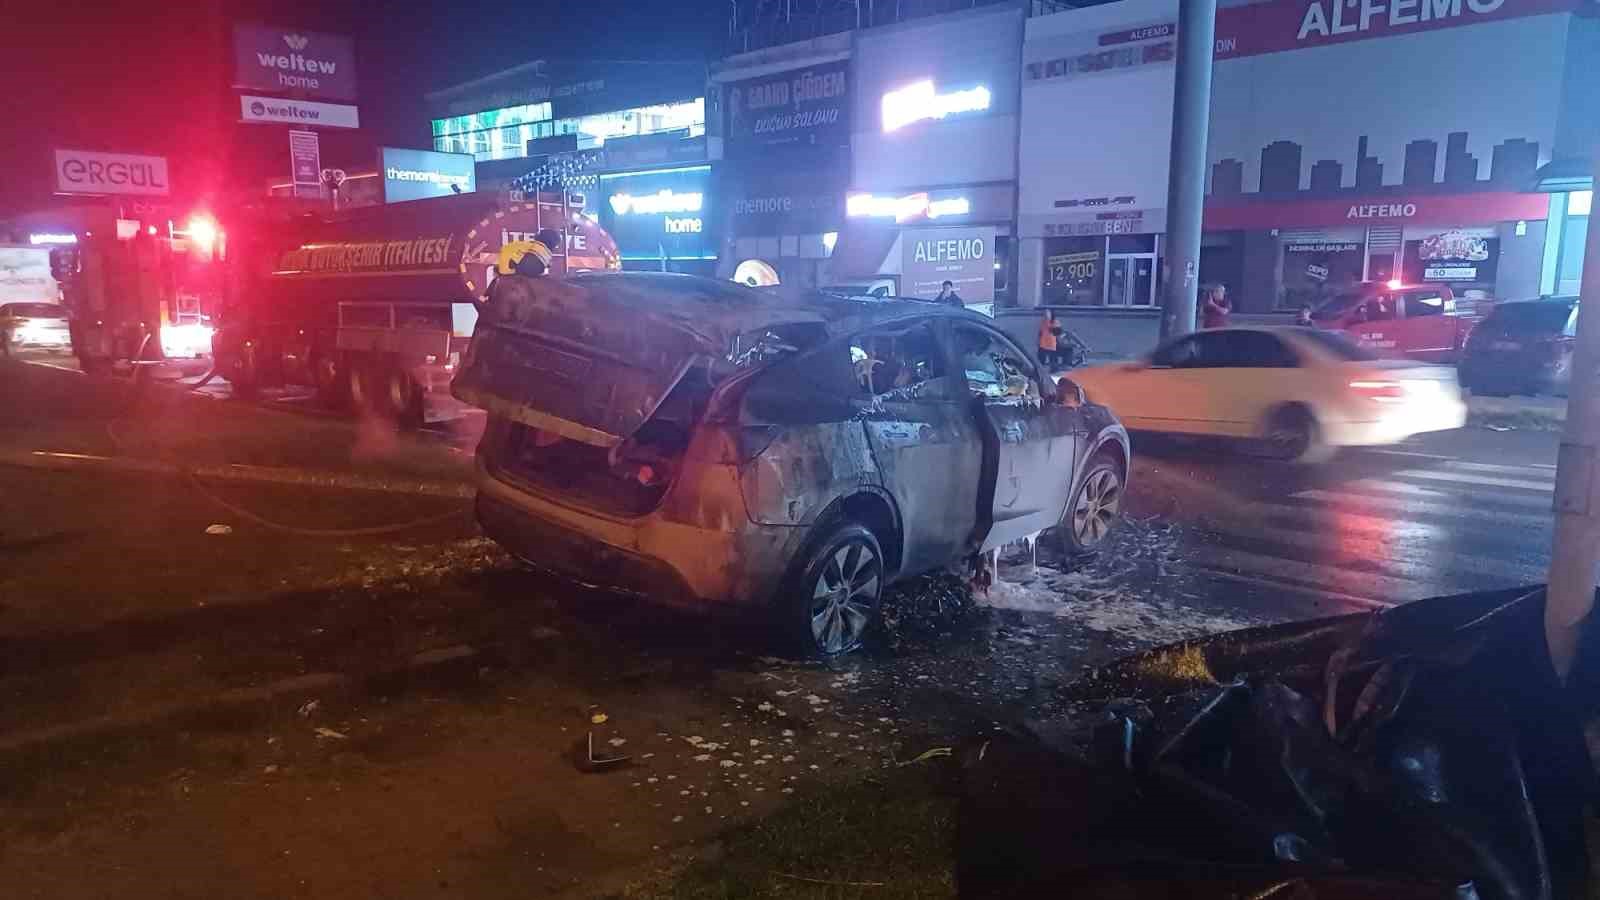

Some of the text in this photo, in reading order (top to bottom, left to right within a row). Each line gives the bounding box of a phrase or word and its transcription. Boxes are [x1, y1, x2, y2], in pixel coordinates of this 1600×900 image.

[1130, 26, 1169, 41] ALFEMO
[257, 52, 336, 75] weltew
[278, 71, 320, 89] home
[266, 105, 320, 119] weltew
[1347, 203, 1417, 219] ALFEMO
[664, 215, 703, 234] home
[914, 238, 984, 263] ALFEMO
